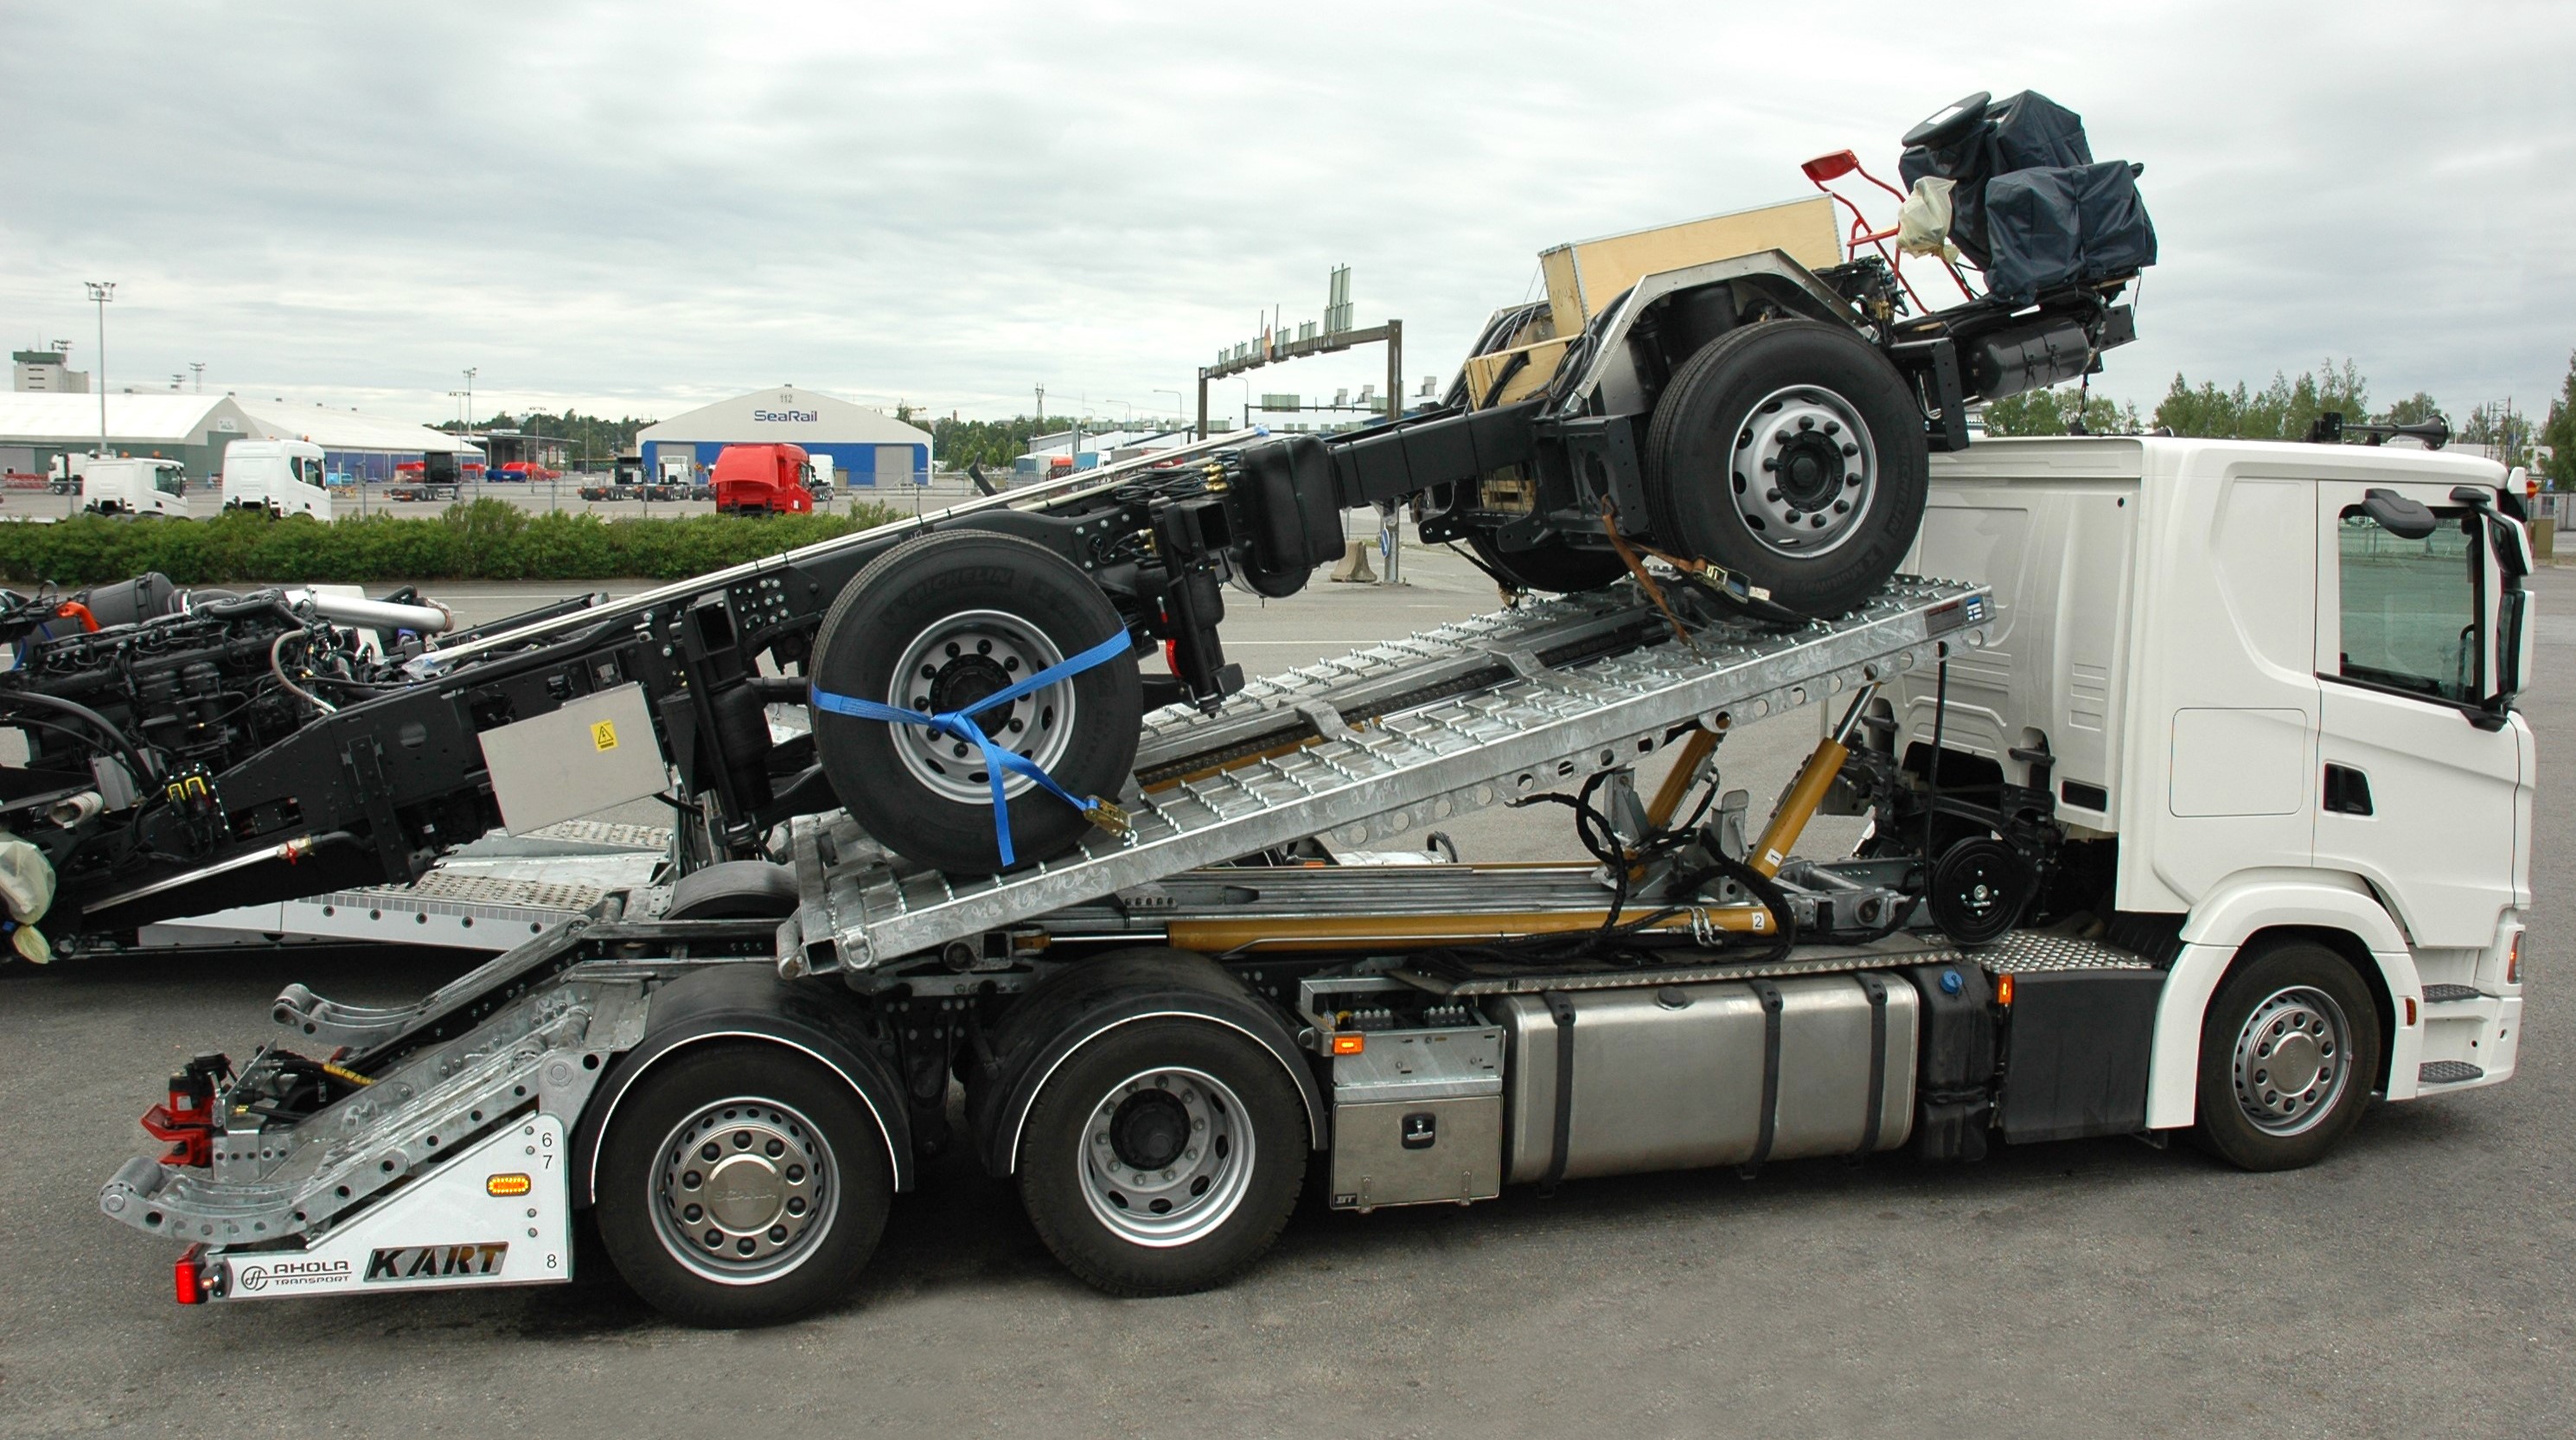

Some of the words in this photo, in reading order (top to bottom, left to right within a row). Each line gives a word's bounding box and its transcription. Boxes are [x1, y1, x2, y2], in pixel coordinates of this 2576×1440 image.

[754, 410, 818, 422] SeaRail
[907, 567, 1012, 604] MICHELIN
[1754, 915, 1763, 928] 2
[542, 1132, 553, 1148] 6
[543, 1155, 553, 1169] 7
[273, 1259, 349, 1275] AHOLA
[368, 1244, 508, 1280] KART
[547, 1253, 558, 1269] 8
[274, 1276, 350, 1286] TRANSPORT
